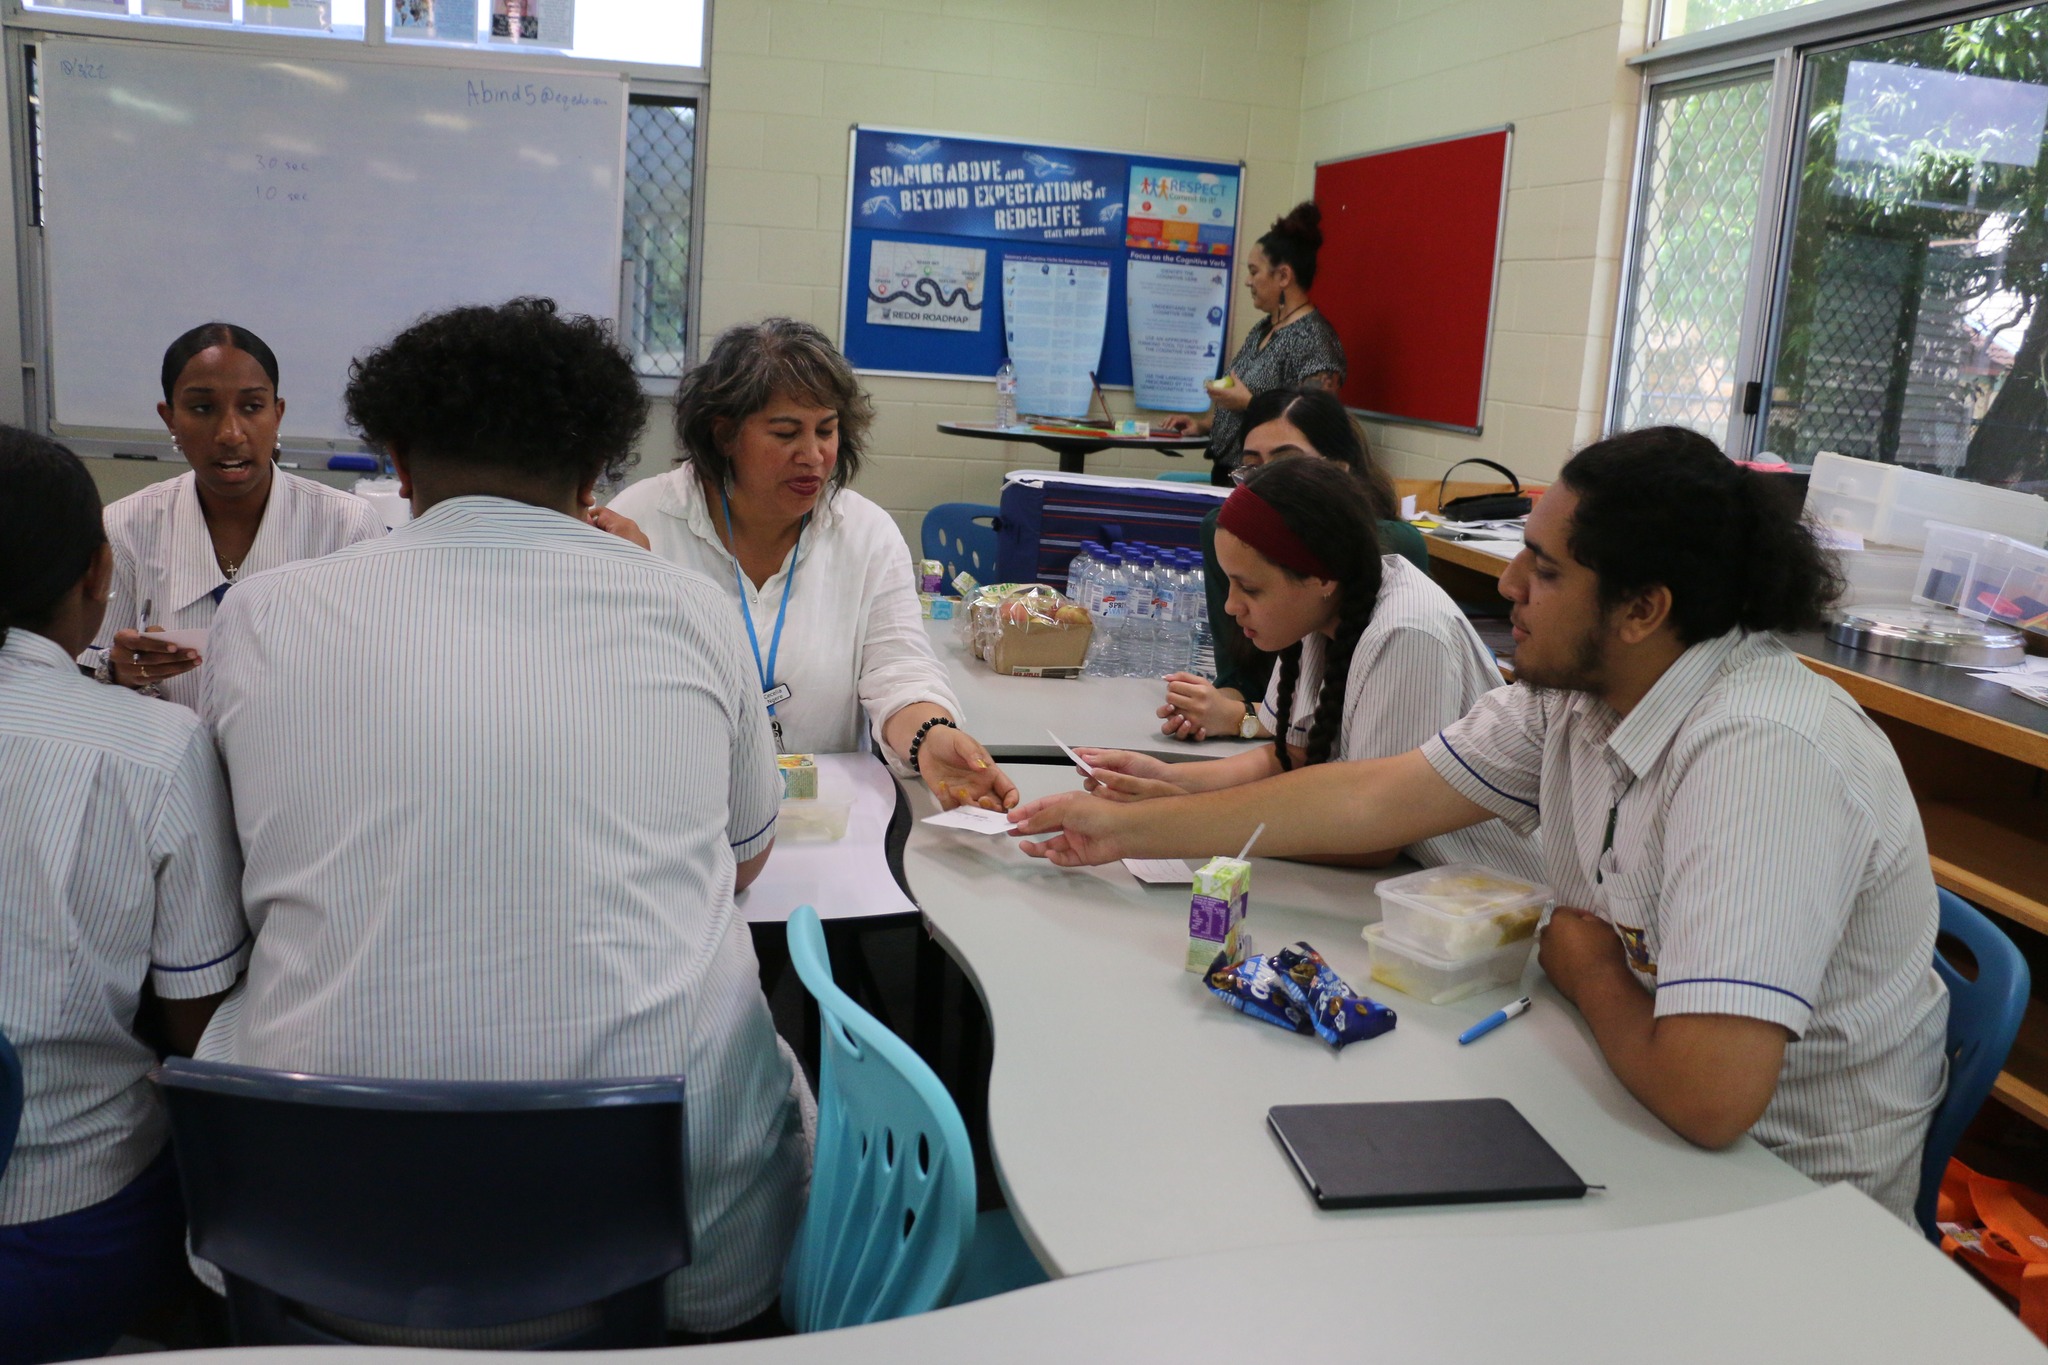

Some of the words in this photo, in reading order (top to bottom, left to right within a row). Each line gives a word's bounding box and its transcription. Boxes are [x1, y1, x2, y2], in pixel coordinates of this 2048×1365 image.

[870, 162, 944, 187] SOARING
[946, 160, 1002, 183] ABOVE
[1005, 168, 1025, 180] AND
[900, 187, 968, 212] BEYOND
[974, 180, 1093, 208] EXPECTATIONS
[1094, 186, 1106, 199] AT
[1170, 179, 1226, 197] RESPECT
[995, 204, 1081, 231] REDCLIFFE
[1043, 228, 1063, 238] STATE
[1064, 228, 1080, 237] HIGH
[1081, 226, 1106, 237] SCHOOL
[1130, 251, 1150, 260] Focus
[1162, 253, 1174, 261] the
[1176, 255, 1208, 265] Cognitive
[1209, 259, 1226, 267] Verb
[892, 311, 920, 320] REDDI
[922, 312, 968, 324] ROADMAP
